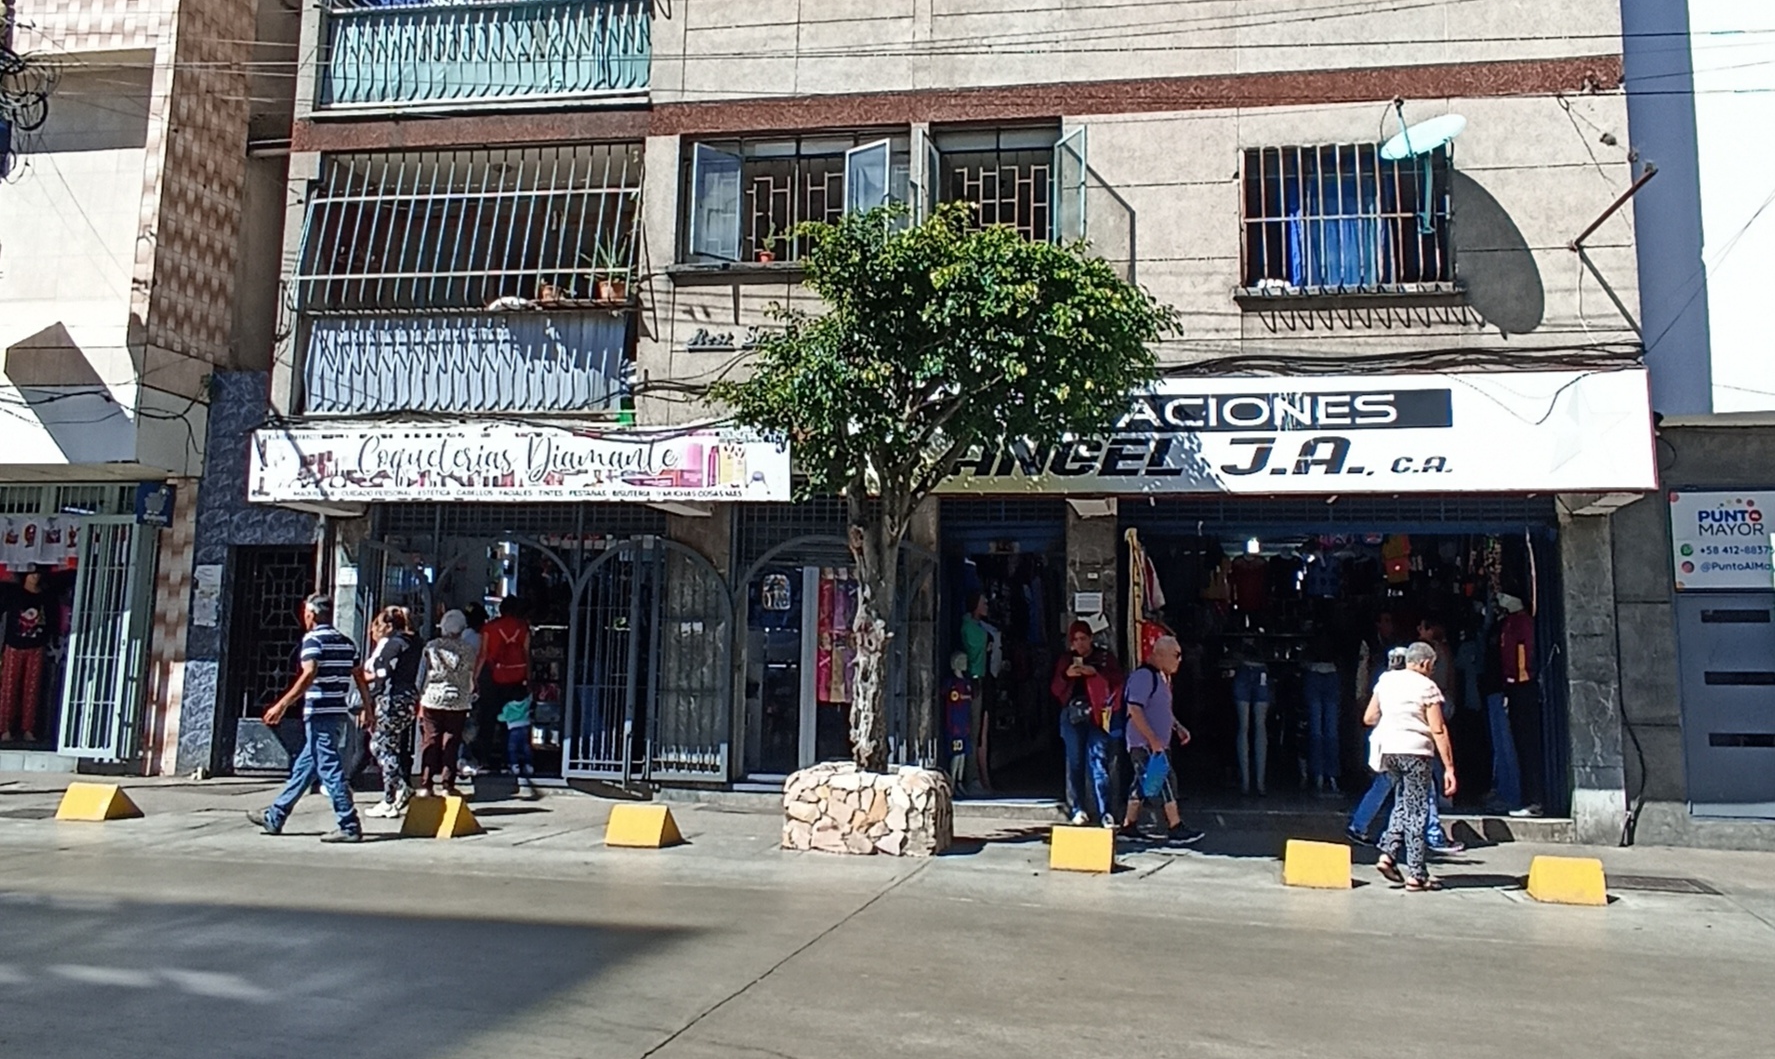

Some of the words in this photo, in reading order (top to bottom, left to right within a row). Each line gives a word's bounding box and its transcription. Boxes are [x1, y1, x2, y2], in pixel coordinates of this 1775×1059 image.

[1115, 394, 1398, 428] ACIONES
[527, 434, 678, 482] Diamante
[1390, 456, 1454, 473] C.A.
[1698, 509, 1762, 522] PUNTO
[1698, 523, 1764, 536] MAYOR
